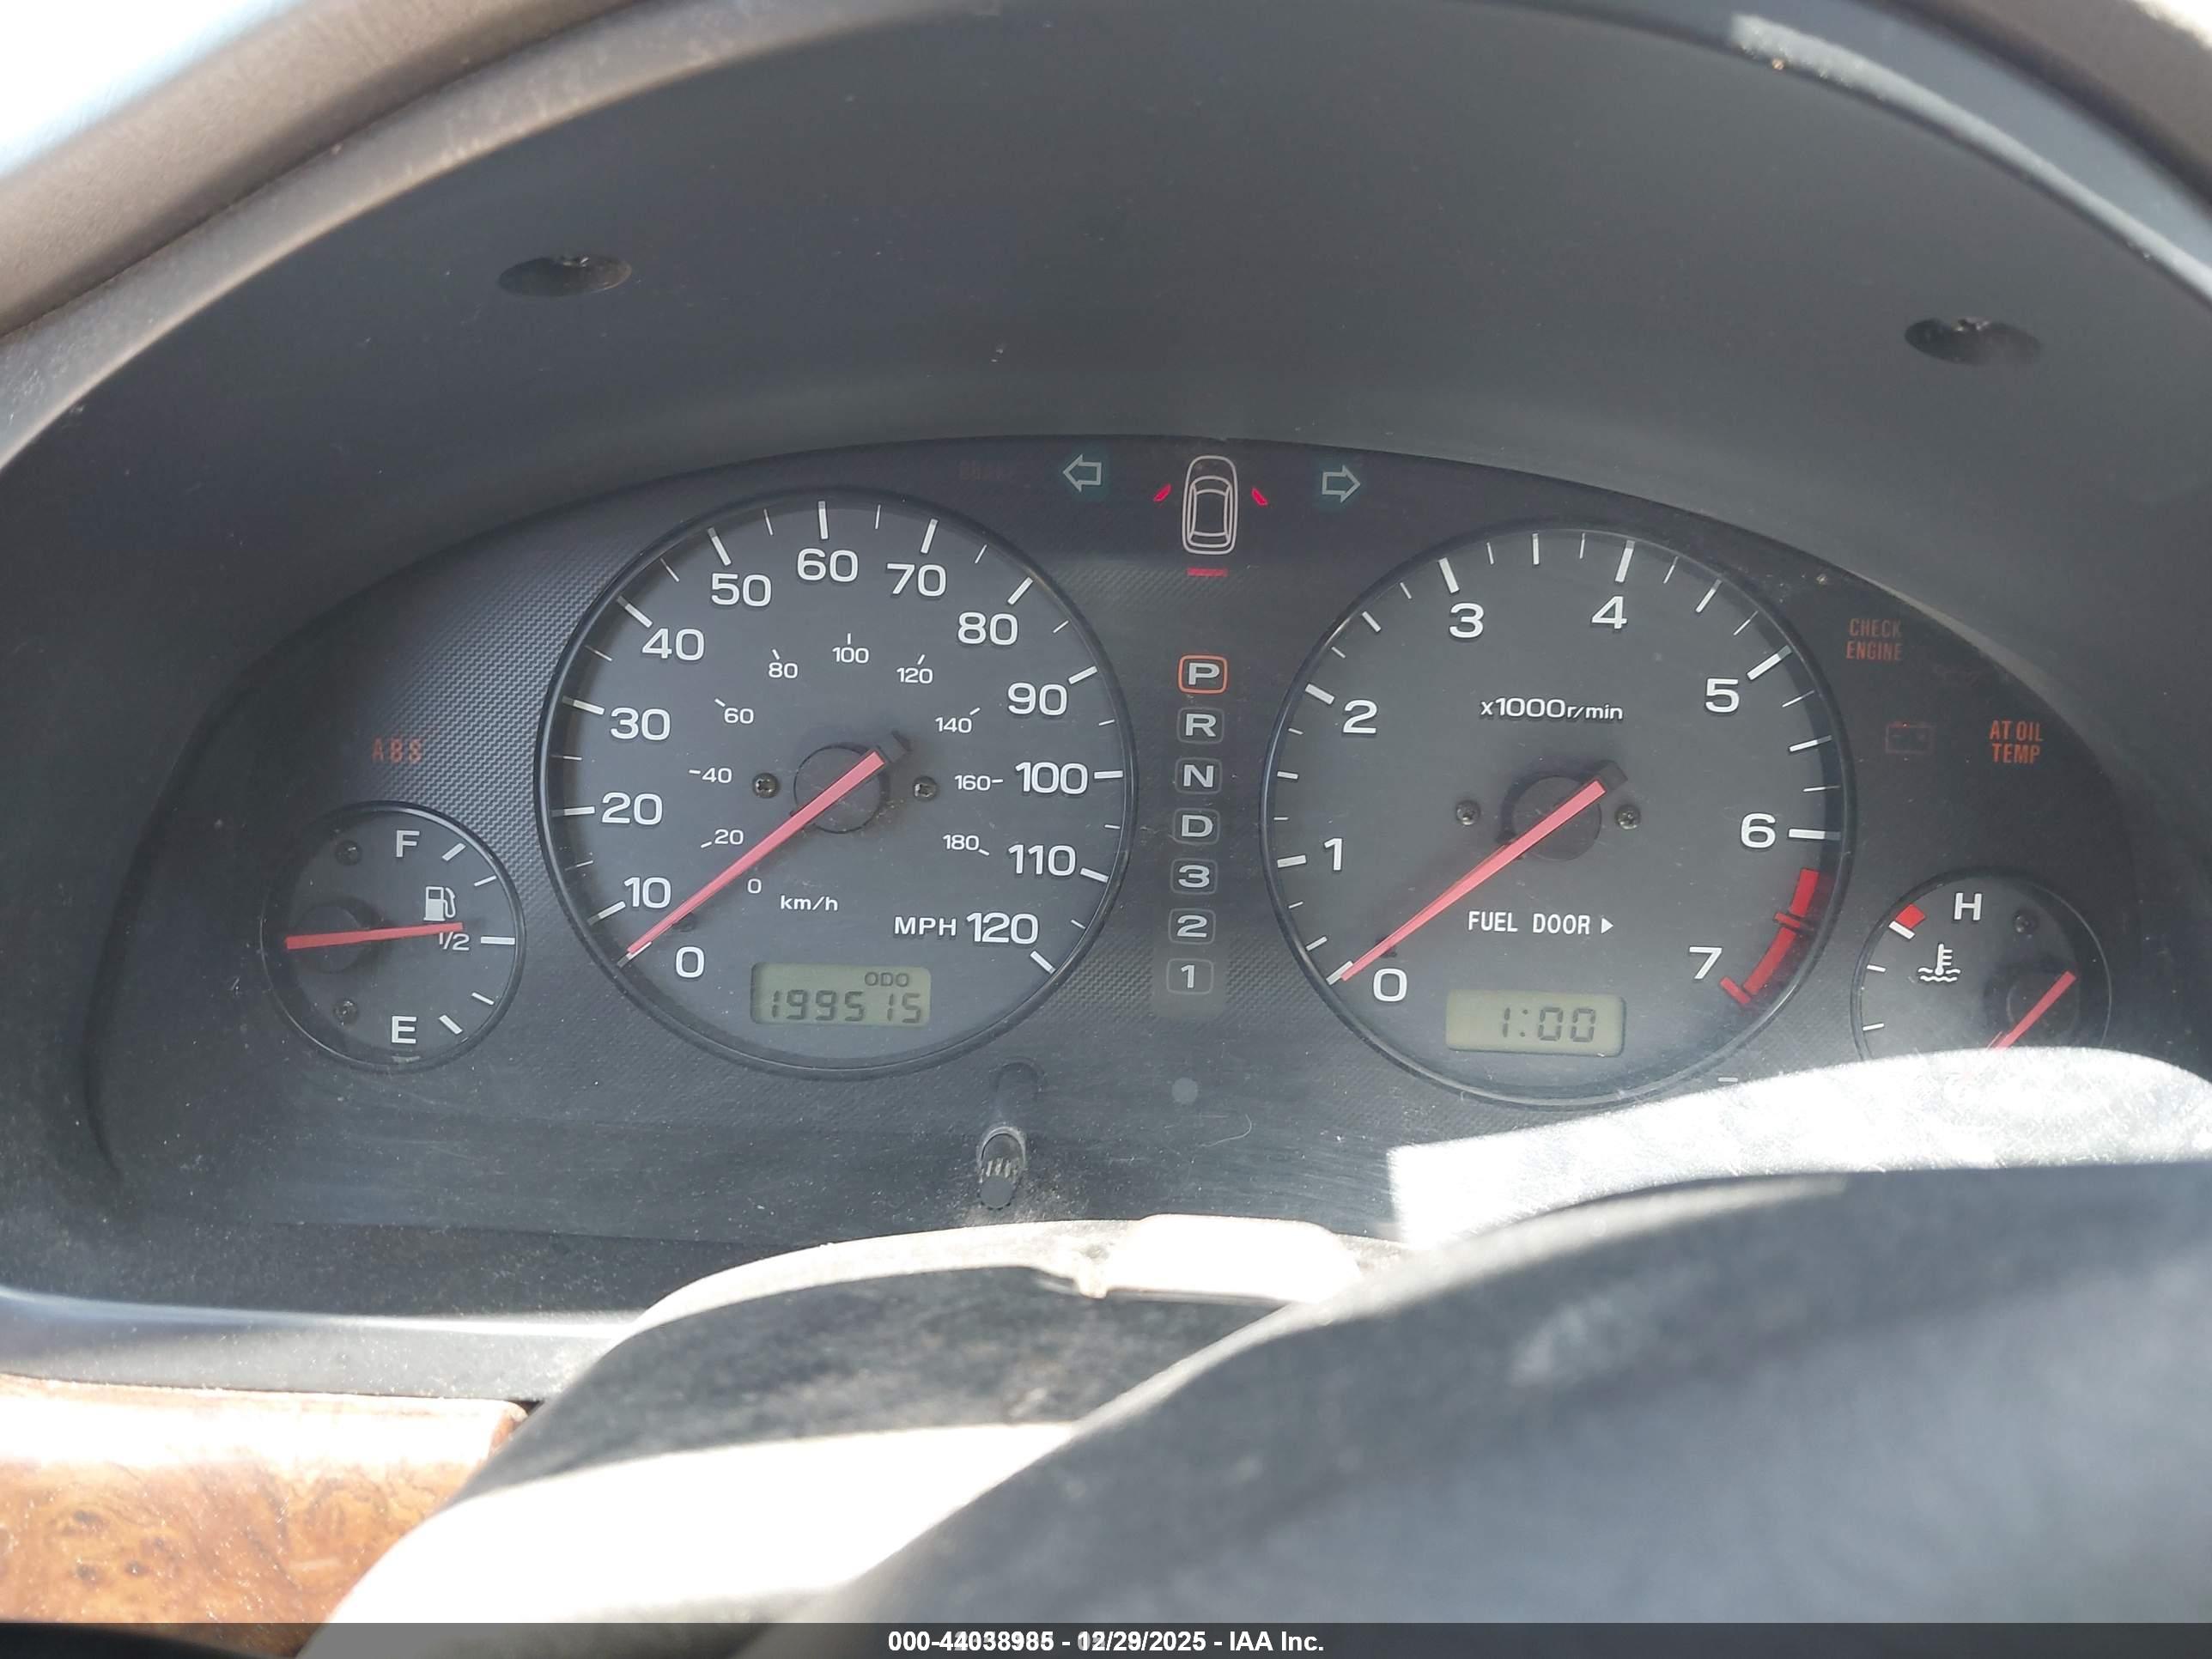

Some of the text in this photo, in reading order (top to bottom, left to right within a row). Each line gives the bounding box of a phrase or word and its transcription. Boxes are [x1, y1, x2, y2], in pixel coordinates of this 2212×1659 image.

[796, 548, 859, 582] 60
[710, 574, 772, 607] 50
[886, 562, 946, 598] 70
[1449, 602, 1485, 639] 3
[1591, 595, 1628, 630] 4
[957, 611, 1018, 646] 80
[1849, 618, 1903, 639] CHECK
[641, 627, 706, 662] 40
[832, 647, 870, 664] 100
[1845, 641, 1904, 661] ENGINE
[769, 661, 799, 679] 80
[896, 667, 933, 684] 120
[1188, 662, 1220, 685] P
[1006, 683, 1067, 717] 90
[1480, 696, 1623, 722] x1000r/min
[1705, 678, 1741, 714] 5
[610, 707, 672, 741] 30
[724, 707, 755, 725] 60
[935, 717, 973, 734] 140
[1184, 713, 1217, 738] R
[1342, 700, 1378, 736] 2
[1989, 720, 2045, 742] AT OIL
[372, 738, 422, 764] ABS
[1991, 743, 2042, 764] TEMP
[701, 767, 733, 784] 40
[954, 774, 992, 792] 160
[1015, 761, 1088, 795] 100
[1182, 764, 1214, 788] N
[601, 791, 664, 826] 20
[714, 829, 744, 846] 20
[1181, 814, 1214, 837] D
[1740, 813, 1777, 848] 6
[395, 830, 421, 858] F
[943, 834, 981, 852] 180
[1323, 838, 1346, 872] 1
[1008, 843, 1076, 878] 110
[746, 878, 763, 895] 0
[1177, 865, 1211, 888] 3
[623, 876, 672, 909] 10
[780, 895, 839, 913] km/h
[1954, 892, 1984, 921] H
[894, 915, 957, 938] MPH
[966, 911, 1039, 945] 120
[1176, 915, 1207, 938] 2
[1468, 911, 1591, 936] FUEL DOOR
[438, 931, 471, 951] 1/2
[675, 945, 706, 980] 0
[1688, 946, 1723, 981] 7
[864, 971, 910, 988] ODO
[1180, 964, 1196, 988] 1
[1373, 967, 1408, 1002] 0
[771, 989, 922, 1024] 199515
[391, 1015, 417, 1044] E
[1501, 1006, 1596, 1043] 1:00
